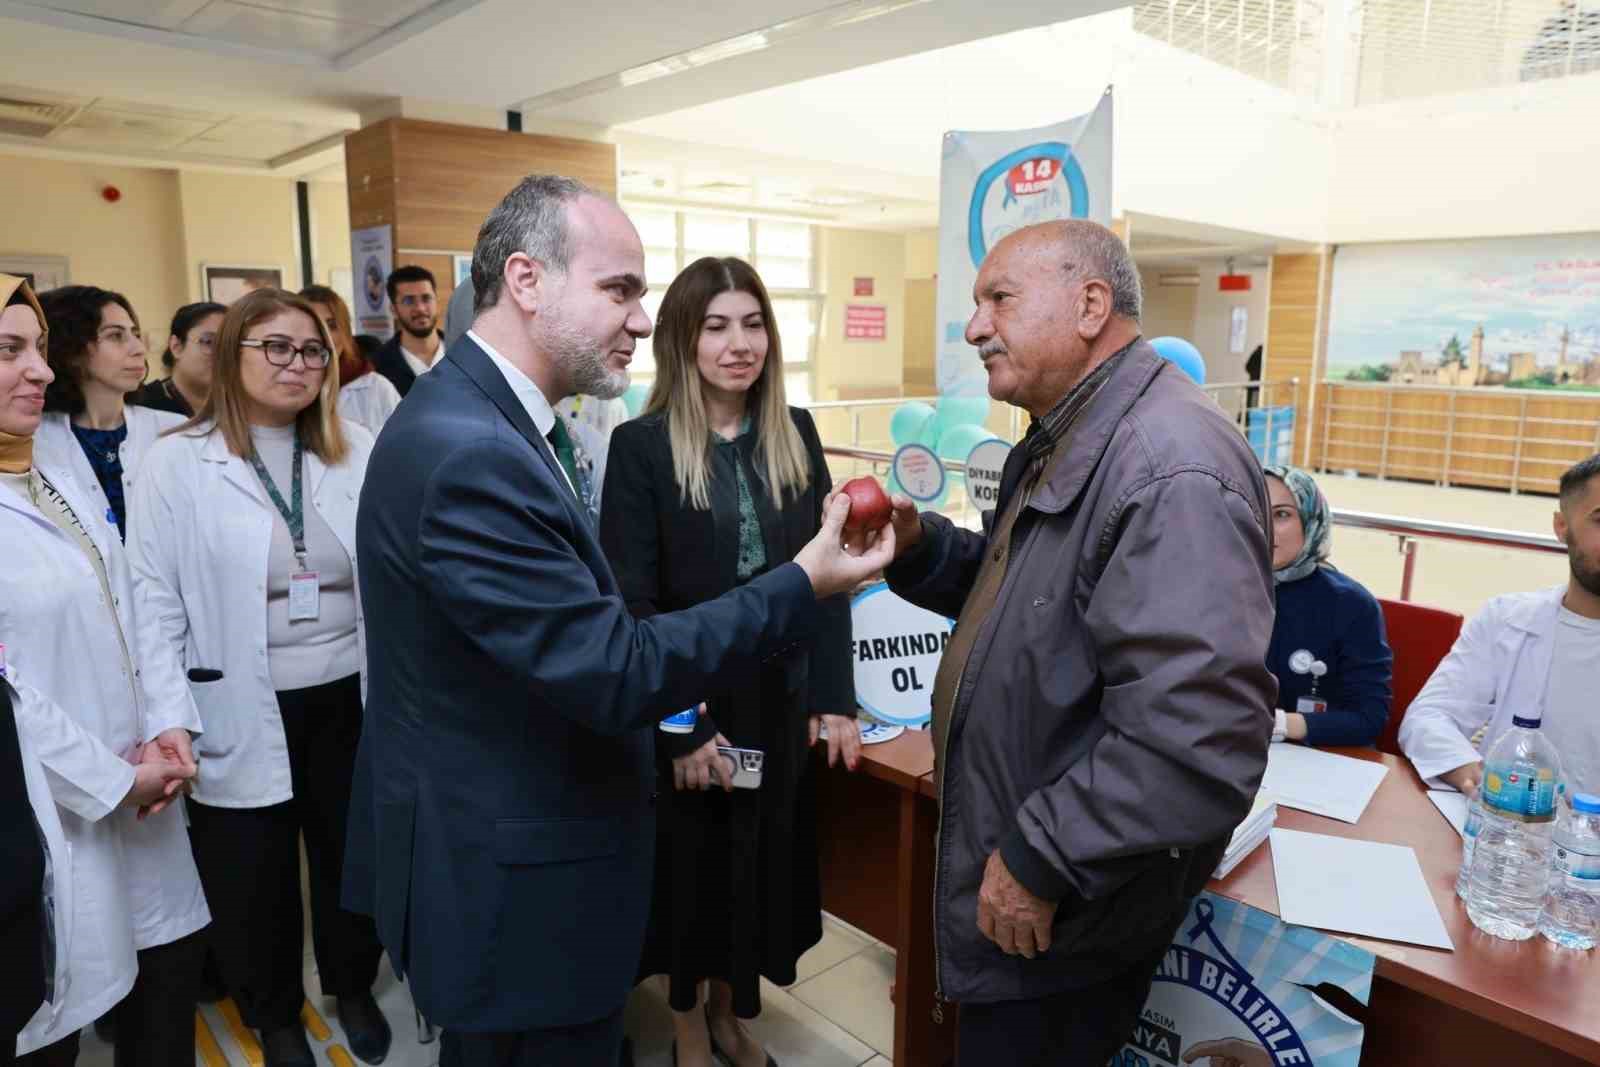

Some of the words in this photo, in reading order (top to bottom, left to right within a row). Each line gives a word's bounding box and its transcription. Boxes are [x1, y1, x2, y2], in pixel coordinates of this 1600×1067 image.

[1022, 160, 1052, 180] 14
[892, 667, 923, 692] OL
[1144, 1009, 1176, 1031] ASIM
